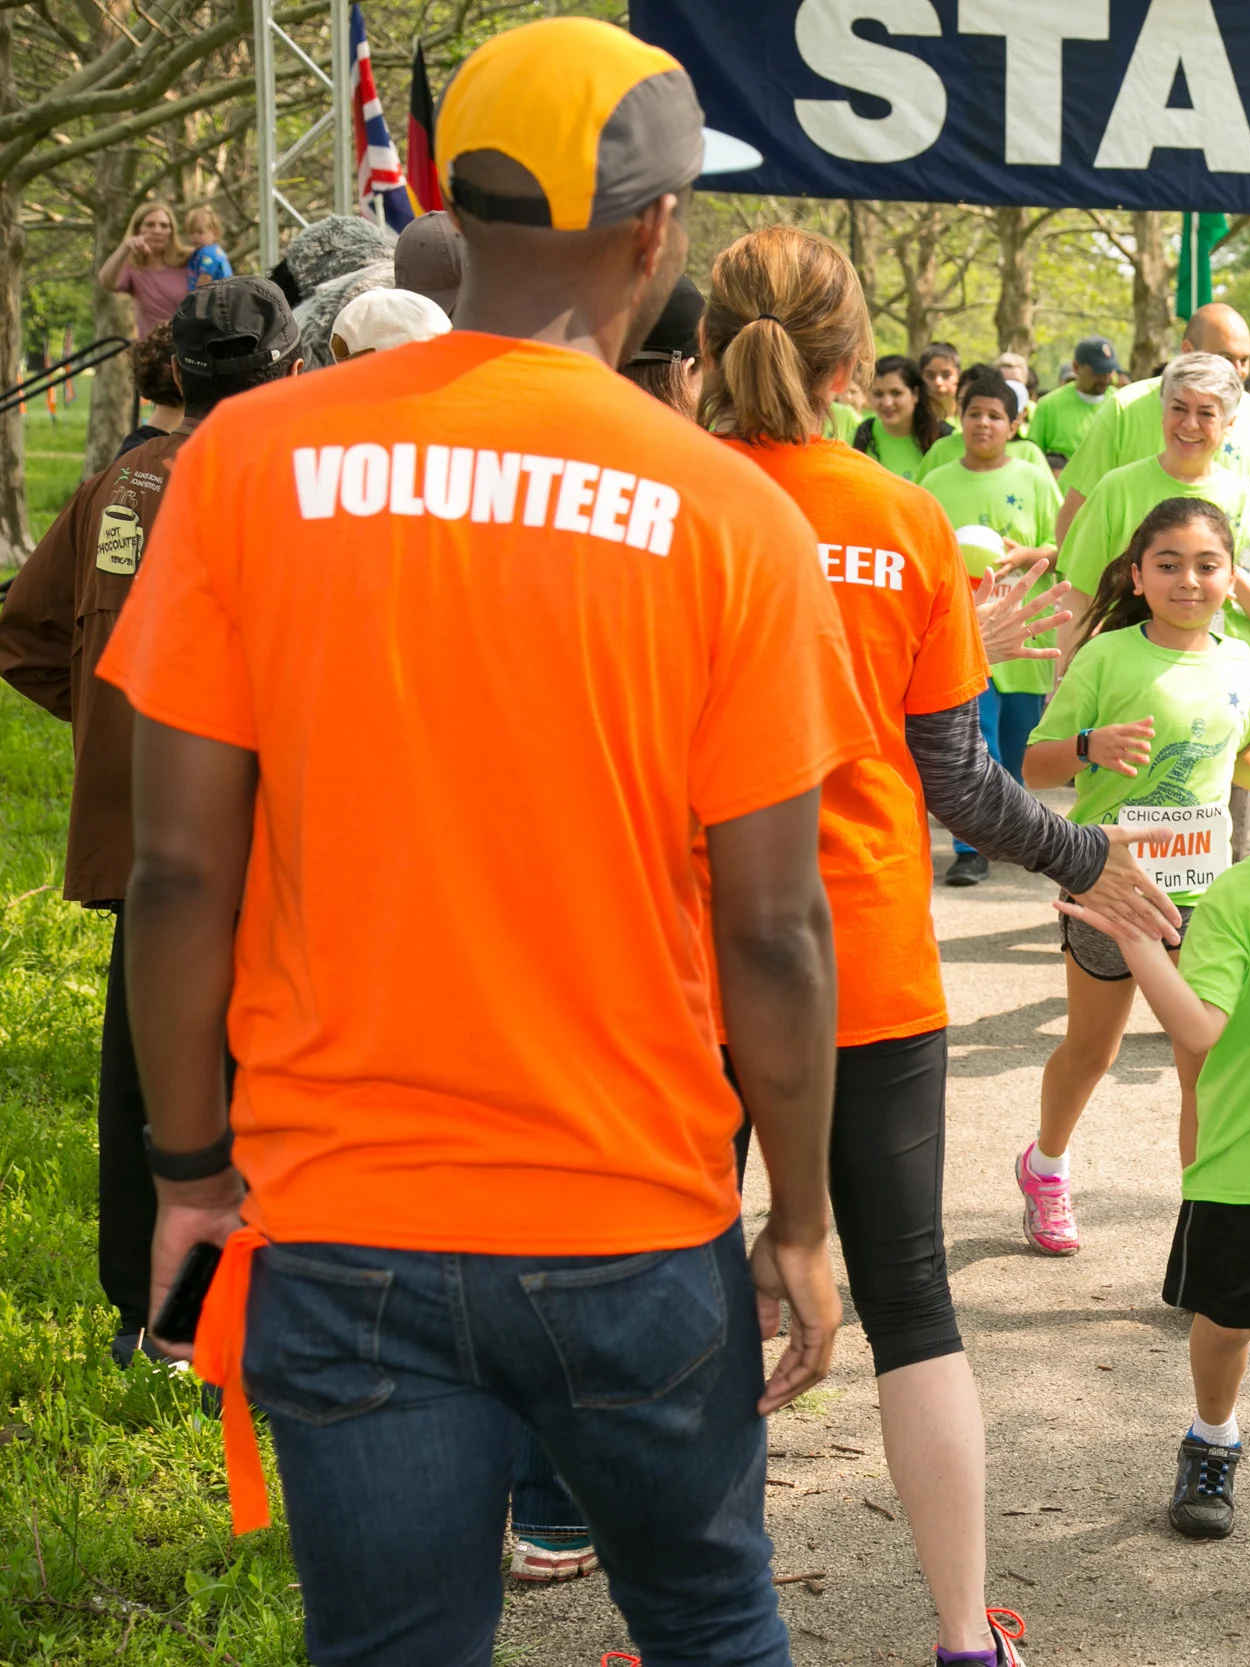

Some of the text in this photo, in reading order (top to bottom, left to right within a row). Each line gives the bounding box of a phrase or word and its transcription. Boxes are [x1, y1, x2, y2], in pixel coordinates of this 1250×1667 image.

[293, 442, 681, 557] VOLUNTEER
[106, 526, 121, 538] HOT
[1126, 809, 1193, 823] CHICAGO
[1196, 806, 1222, 820] RUN
[1155, 868, 1214, 888] Fun Run
